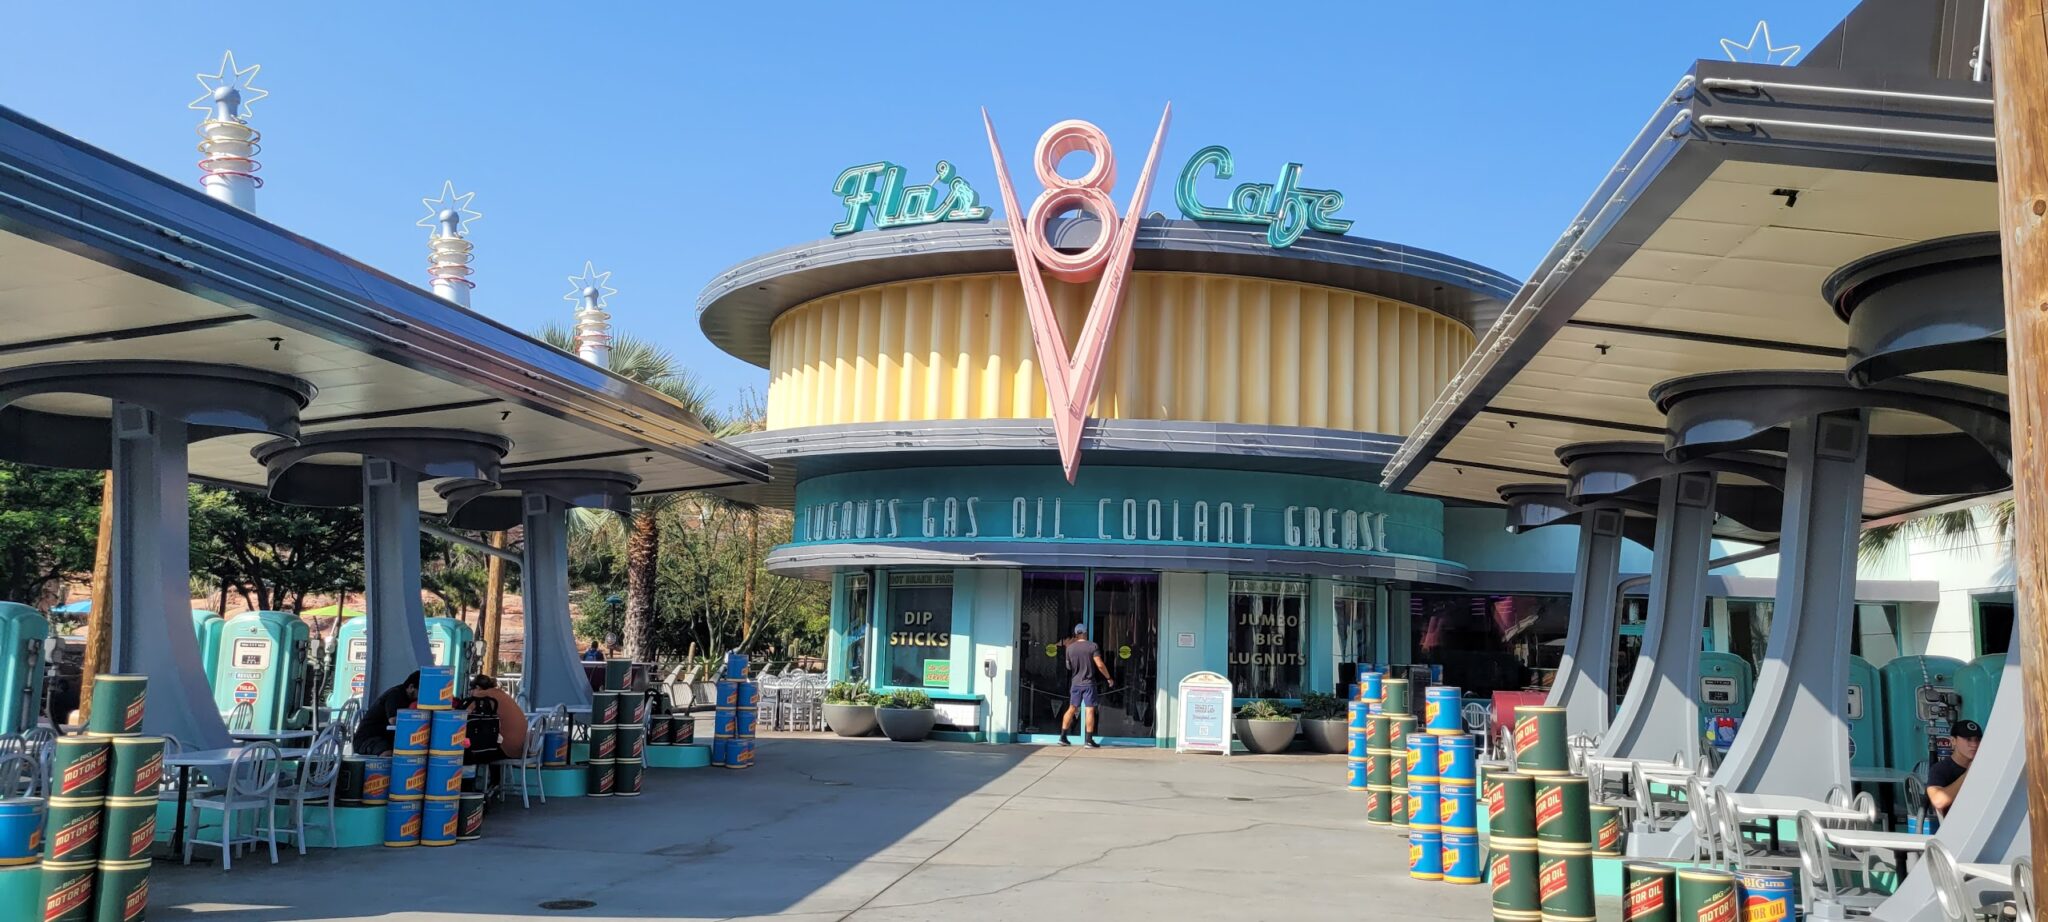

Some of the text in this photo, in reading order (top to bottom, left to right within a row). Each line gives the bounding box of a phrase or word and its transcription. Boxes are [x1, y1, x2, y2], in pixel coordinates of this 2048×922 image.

[831, 160, 993, 236] Flo's
[1175, 145, 1355, 249] Cafe
[804, 497, 1388, 552] LUGNUTS GAS OIL COOLANT GREASE
[904, 611, 933, 625] DIP
[1239, 614, 1299, 628] JUMBO
[889, 632, 949, 647] STICKS
[1255, 634, 1284, 646] BIG
[1229, 652, 1306, 666] LUGNUTS
[1525, 722, 1537, 737] OIL
[64, 763, 97, 783] MOTOR
[1493, 790, 1503, 803] OIL
[1547, 793, 1561, 807] OIL
[55, 825, 88, 846] MOTOR
[1497, 862, 1509, 874] OIL
[1551, 867, 1566, 880] OIL
[1630, 880, 1641, 889] BIG
[1743, 878, 1765, 888] BIG
[1648, 884, 1662, 898] OIL
[1712, 890, 1724, 901] BIG
[47, 888, 79, 910] MOTOR
[1699, 901, 1729, 922] MOTOR
[1742, 902, 1785, 922] OTOR OIL
